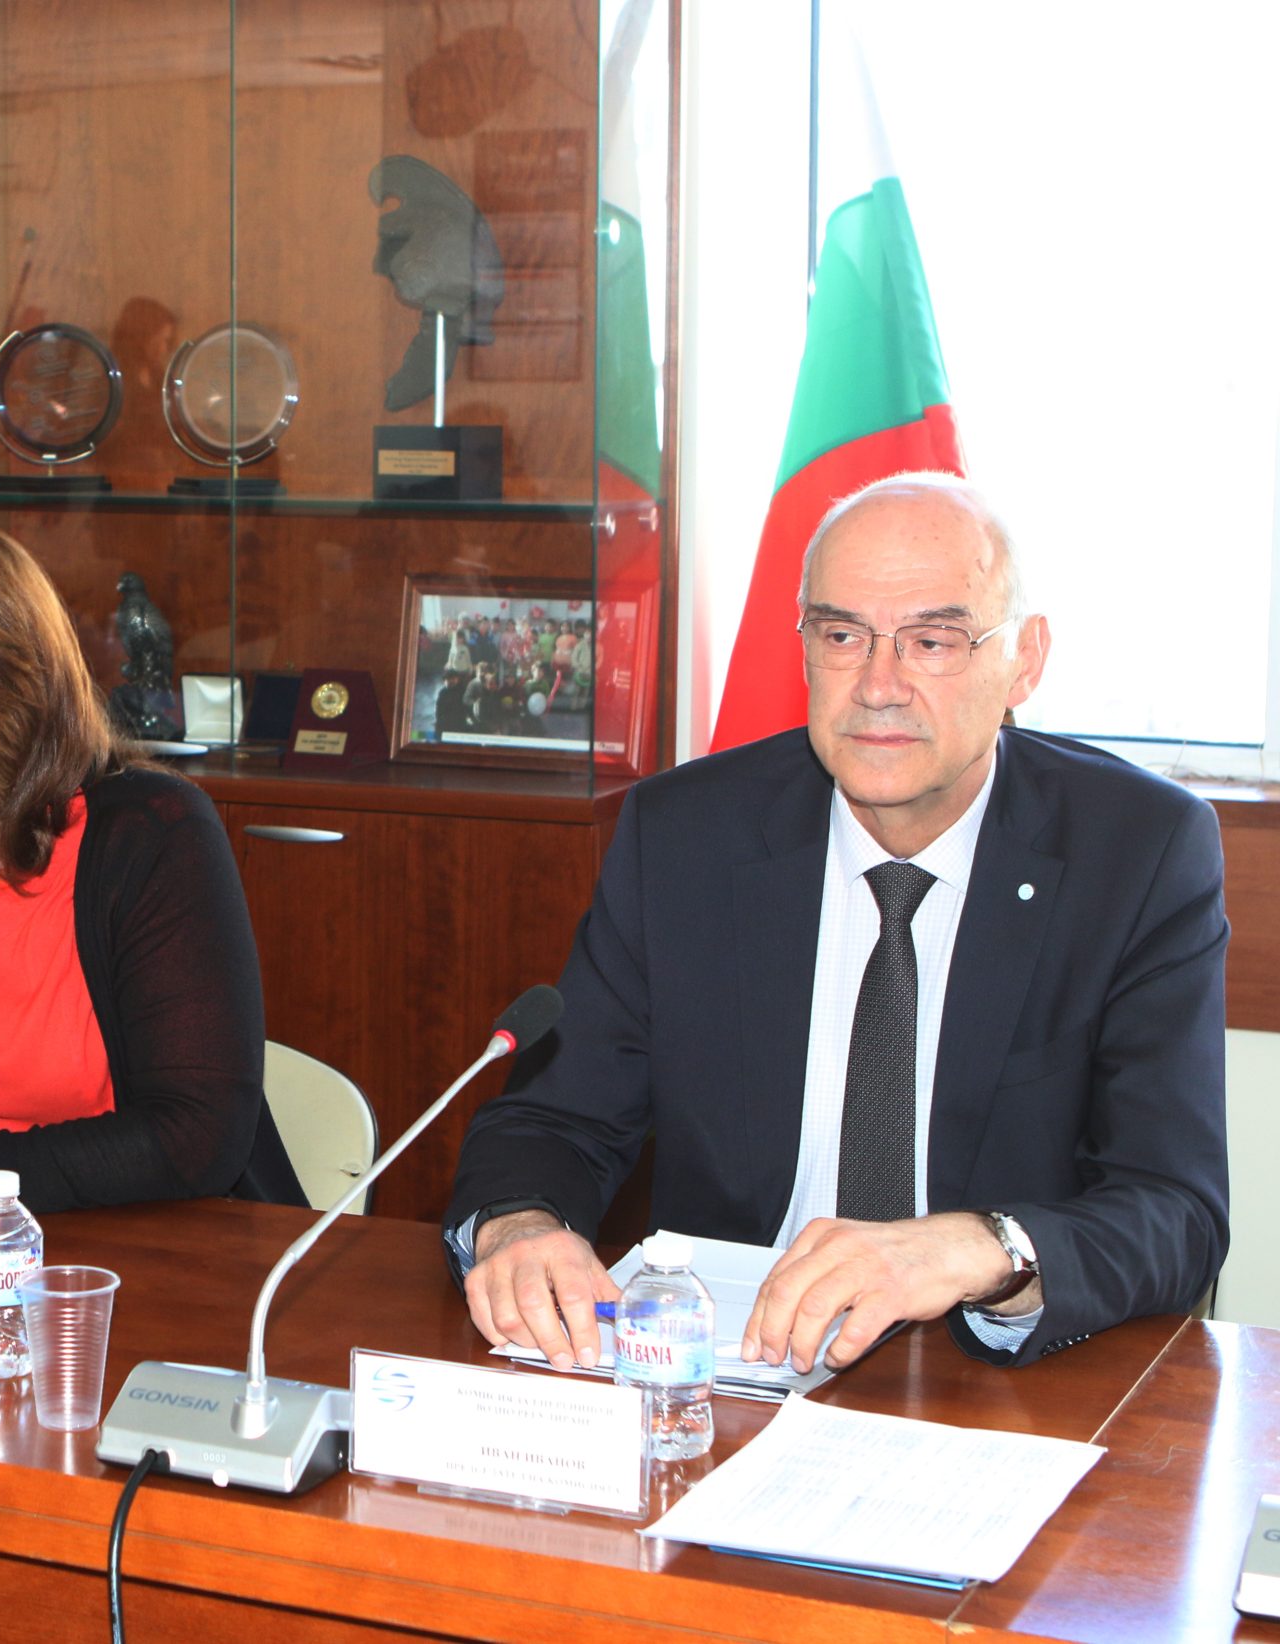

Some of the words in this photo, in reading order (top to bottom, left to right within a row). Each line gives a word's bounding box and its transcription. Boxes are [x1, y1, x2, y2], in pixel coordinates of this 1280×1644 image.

[636, 1343, 672, 1365] BANIA
[129, 1387, 219, 1412] GONSIN
[480, 1445, 520, 1461] ИВАН
[525, 1451, 586, 1470] ИВАНОВ
